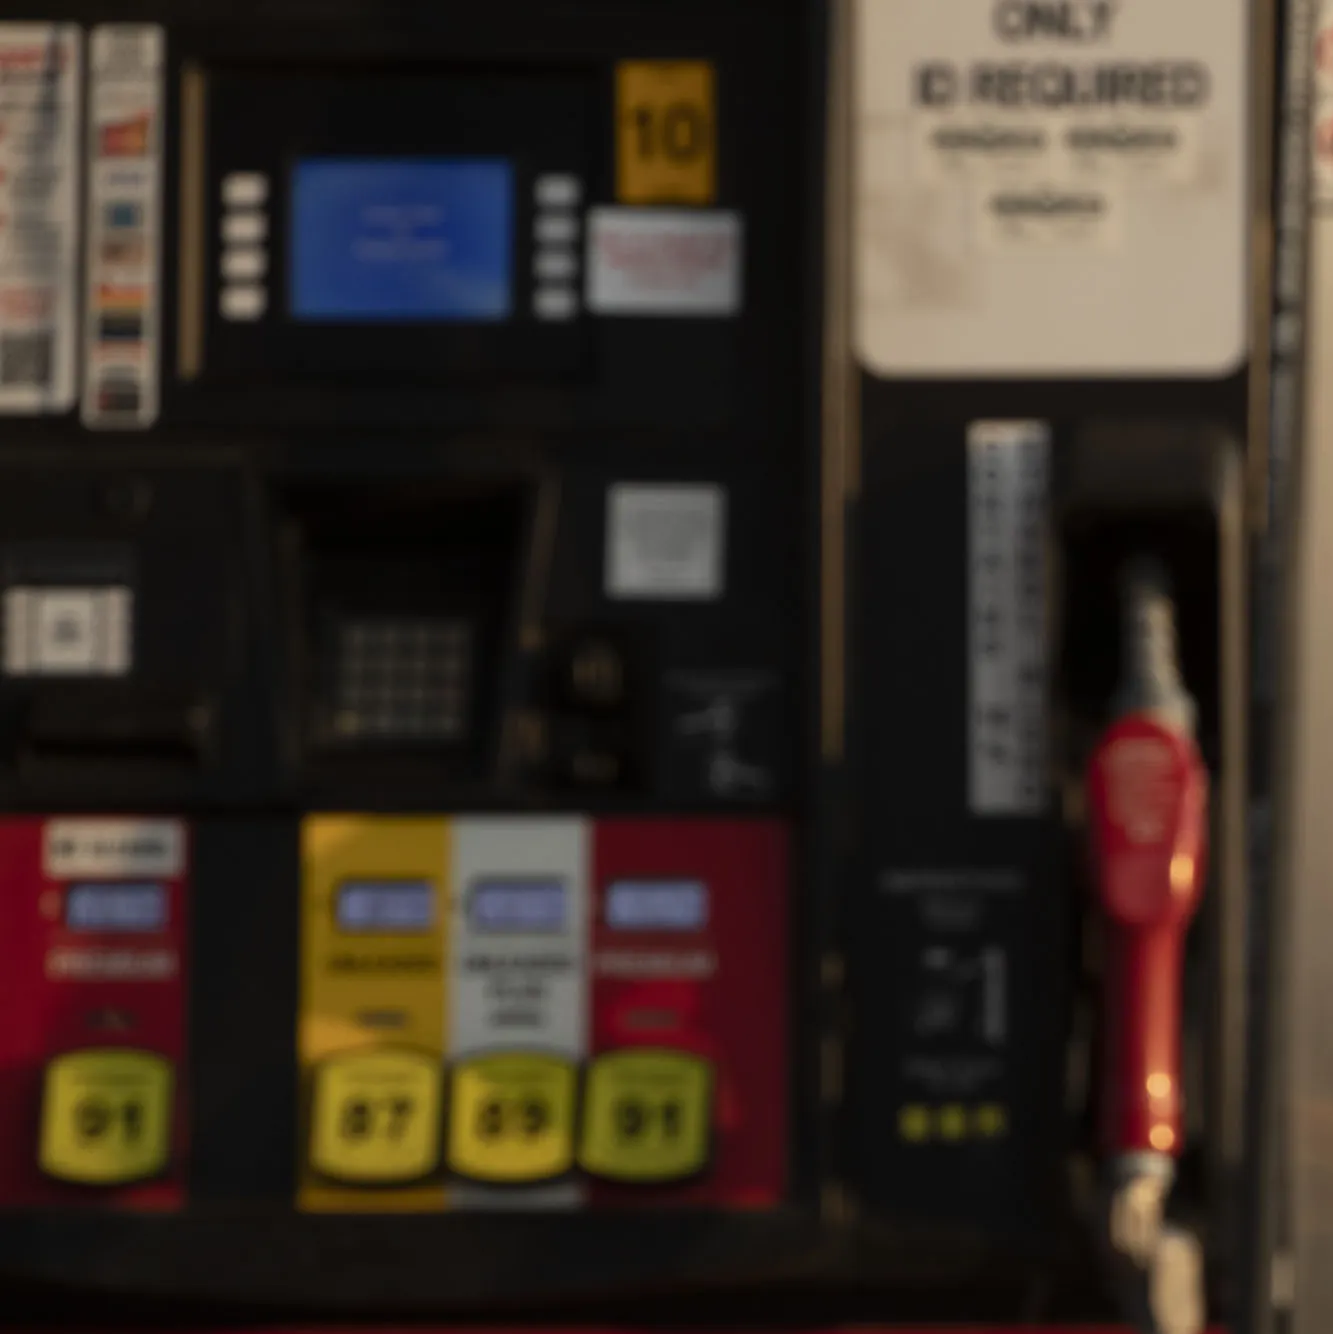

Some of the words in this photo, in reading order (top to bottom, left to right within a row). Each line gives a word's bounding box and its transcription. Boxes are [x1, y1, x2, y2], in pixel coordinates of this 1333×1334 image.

[993, 0, 1115, 43] ONLY
[914, 60, 958, 107] ID
[970, 60, 1211, 107] REQUIRED
[634, 104, 704, 166] 10
